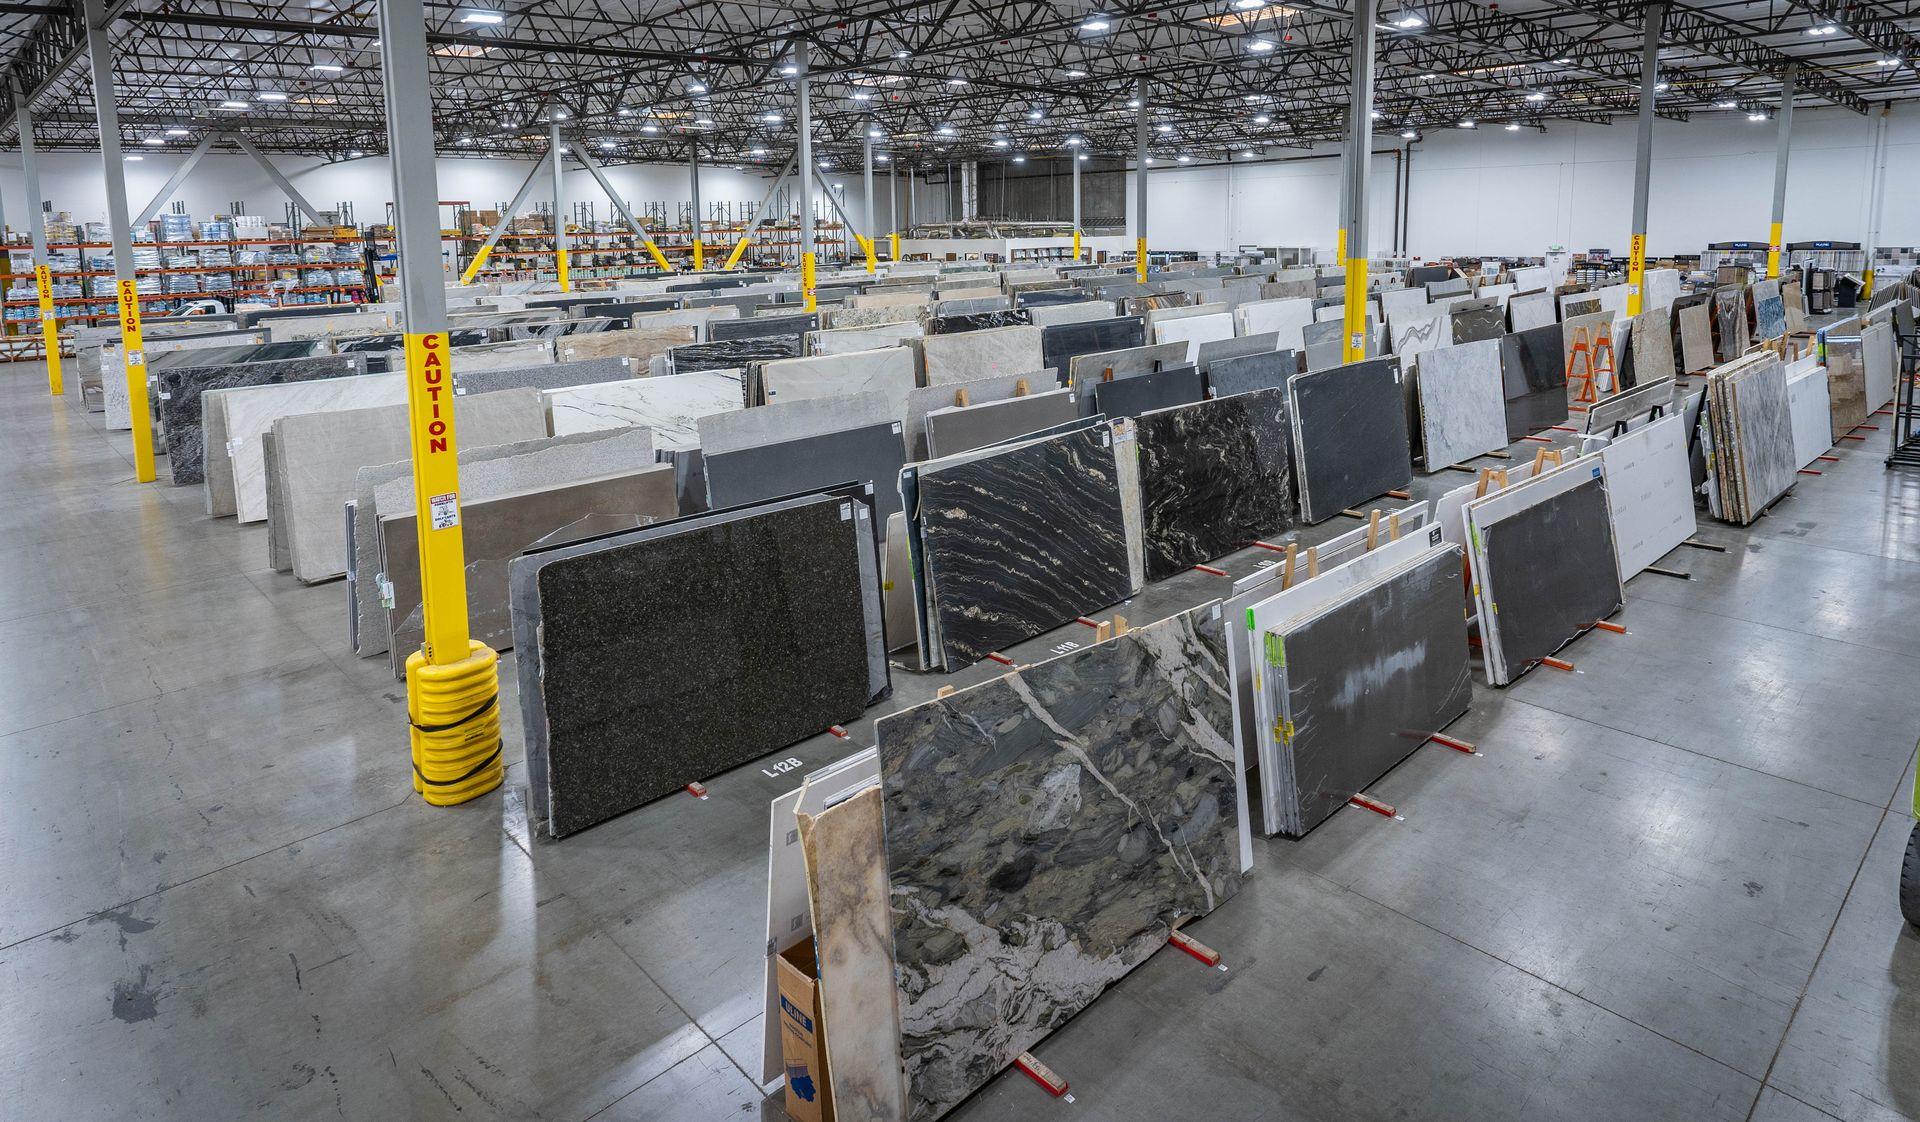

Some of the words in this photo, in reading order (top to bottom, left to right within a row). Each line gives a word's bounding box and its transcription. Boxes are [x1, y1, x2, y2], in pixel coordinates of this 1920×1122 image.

[1632, 235, 1640, 271] CAUTION
[40, 266, 49, 298] CAUTION
[122, 281, 136, 332] CAUTION
[422, 334, 447, 453] CAUTION
[1050, 641, 1079, 654] L11B
[761, 757, 803, 778] L12B
[785, 1000, 807, 1028] ULINE
